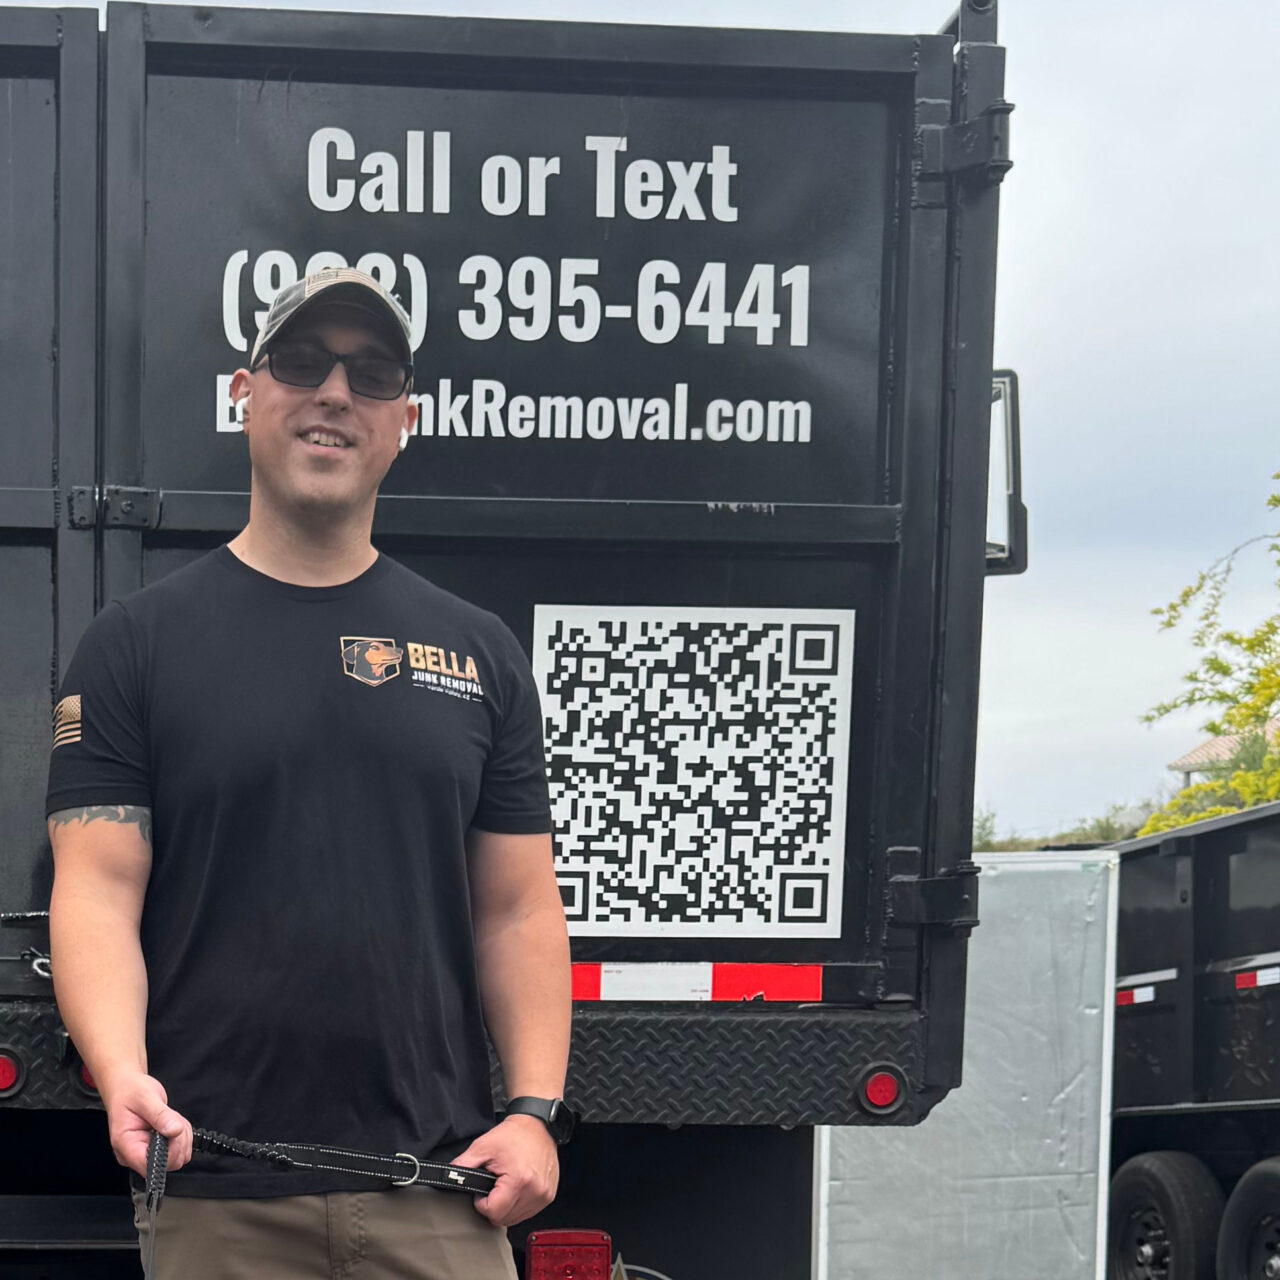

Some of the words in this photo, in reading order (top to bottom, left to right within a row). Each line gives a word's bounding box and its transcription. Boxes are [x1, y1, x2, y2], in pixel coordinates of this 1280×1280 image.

[308, 127, 451, 214] Call
[480, 154, 560, 217] or
[585, 135, 738, 222] Text
[457, 254, 810, 347] 395-6441
[407, 642, 480, 684] BELLA
[411, 670, 438, 684] JUNK
[440, 676, 484, 695] REMOVAL
